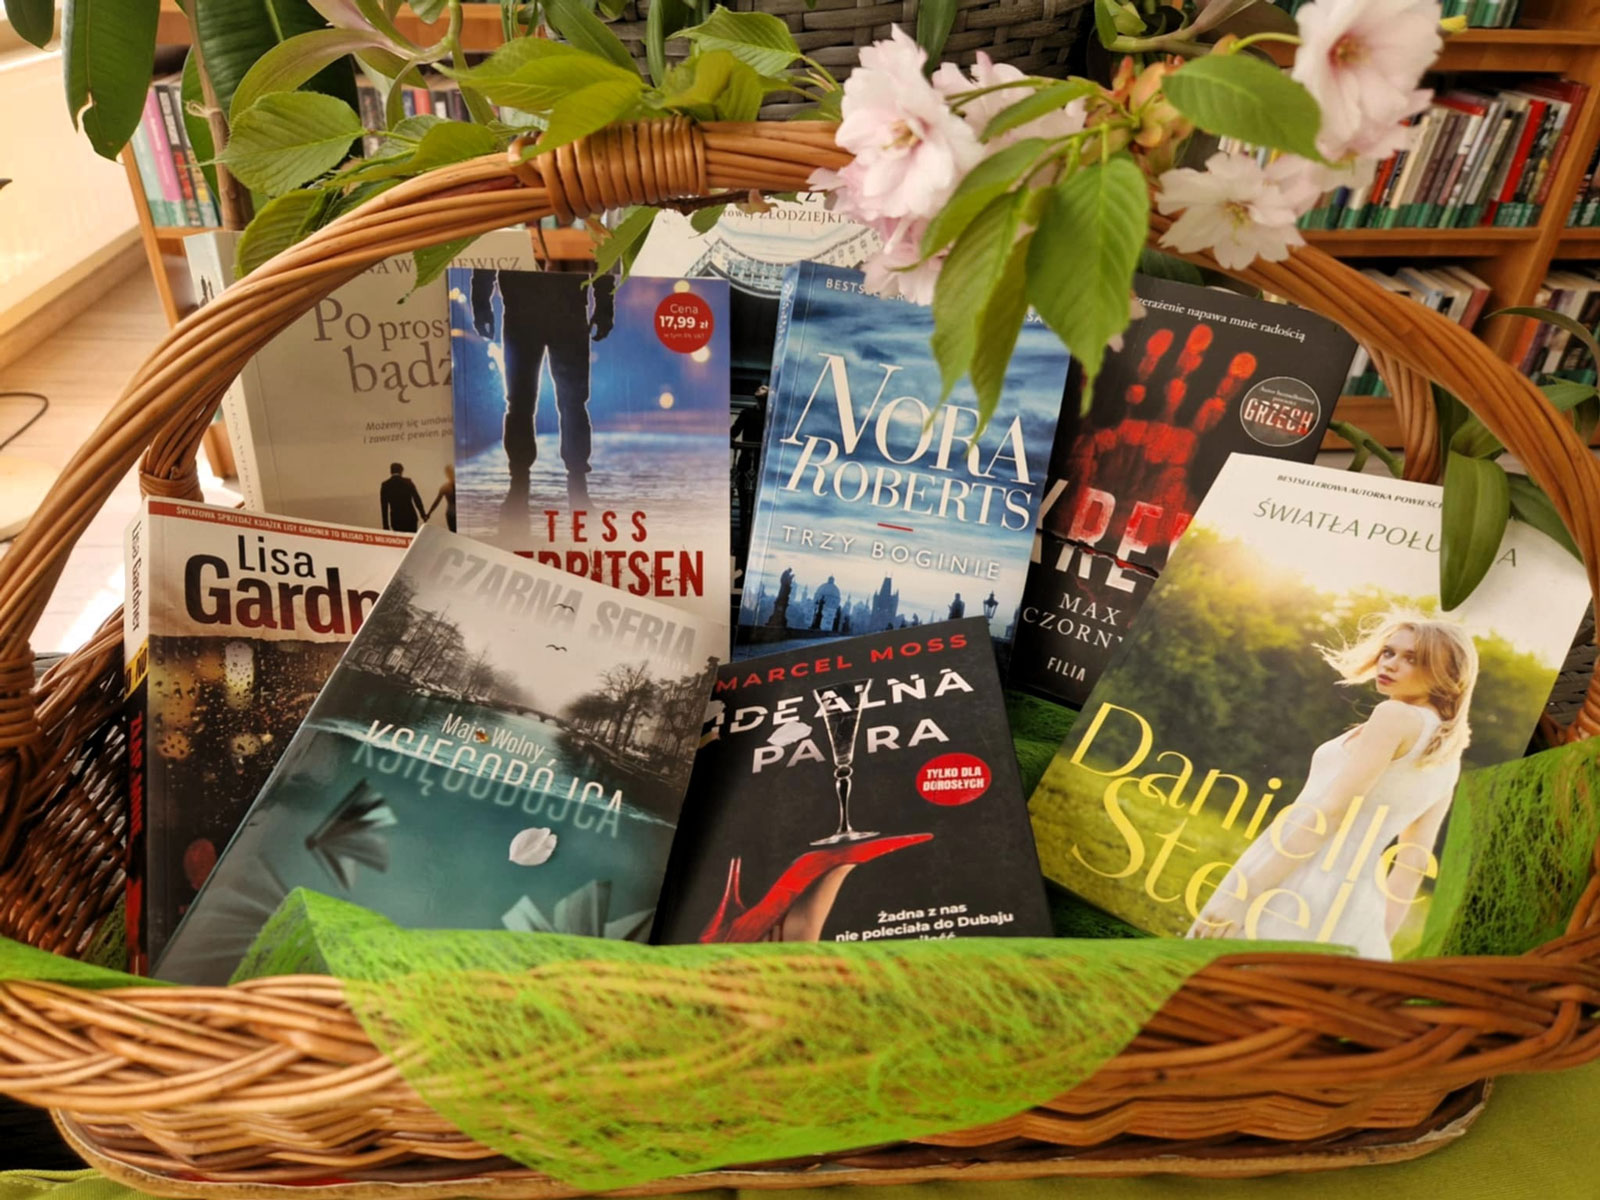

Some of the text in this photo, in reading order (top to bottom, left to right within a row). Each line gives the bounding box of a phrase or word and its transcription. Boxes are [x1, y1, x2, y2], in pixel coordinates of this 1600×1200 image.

[394, 256, 522, 273] WIEWICZ
[313, 297, 371, 341] Po
[659, 315, 709, 330] 17,99 zł
[670, 303, 699, 314] Cena
[1187, 307, 1227, 320] napawa
[1229, 317, 1257, 330] mnie
[1260, 324, 1306, 343] radością
[366, 421, 403, 431] Możemy
[406, 417, 419, 428] się
[780, 352, 1036, 485] NORA
[1244, 398, 1313, 433] GRZECH
[369, 431, 404, 443] zawrzeć
[408, 429, 439, 441] pewien
[779, 435, 1032, 531] ROBERTS
[1277, 474, 1348, 493] BESTSELLEROWA
[1350, 487, 1392, 501] AUTORKA
[176, 505, 215, 520] ŚWIATOWA
[217, 511, 252, 525] SPRZEDAŻ
[254, 516, 281, 529] KSIĄŻEK
[283, 523, 298, 532] LISY
[299, 526, 329, 537] GARDNER
[331, 529, 340, 538] TO
[544, 510, 647, 542] TESS
[1253, 497, 1517, 567] ŚWIATŁA POŁUA
[238, 534, 315, 578] Lisa
[783, 526, 1000, 580] TRZY BOGINIE
[132, 557, 143, 632] Gardner
[428, 546, 696, 664] CZARNA SERIA
[1059, 593, 1122, 626] MAX
[1023, 606, 1124, 649] CZORN
[716, 634, 967, 692] MARCEL MOSS
[1047, 657, 1086, 682] FILIA
[491, 727, 545, 763] Wolny
[922, 778, 984, 792] DOROSŁYCH
[926, 766, 982, 779] TYLKO DLA
[1070, 702, 1439, 905] Danielle
[1072, 777, 1358, 942] Steel
[835, 931, 859, 943] nie
[862, 922, 930, 942] poleciała
[933, 919, 955, 931] do
[957, 911, 1014, 928] Dubaju
[877, 904, 967, 924] Żadna z nas
